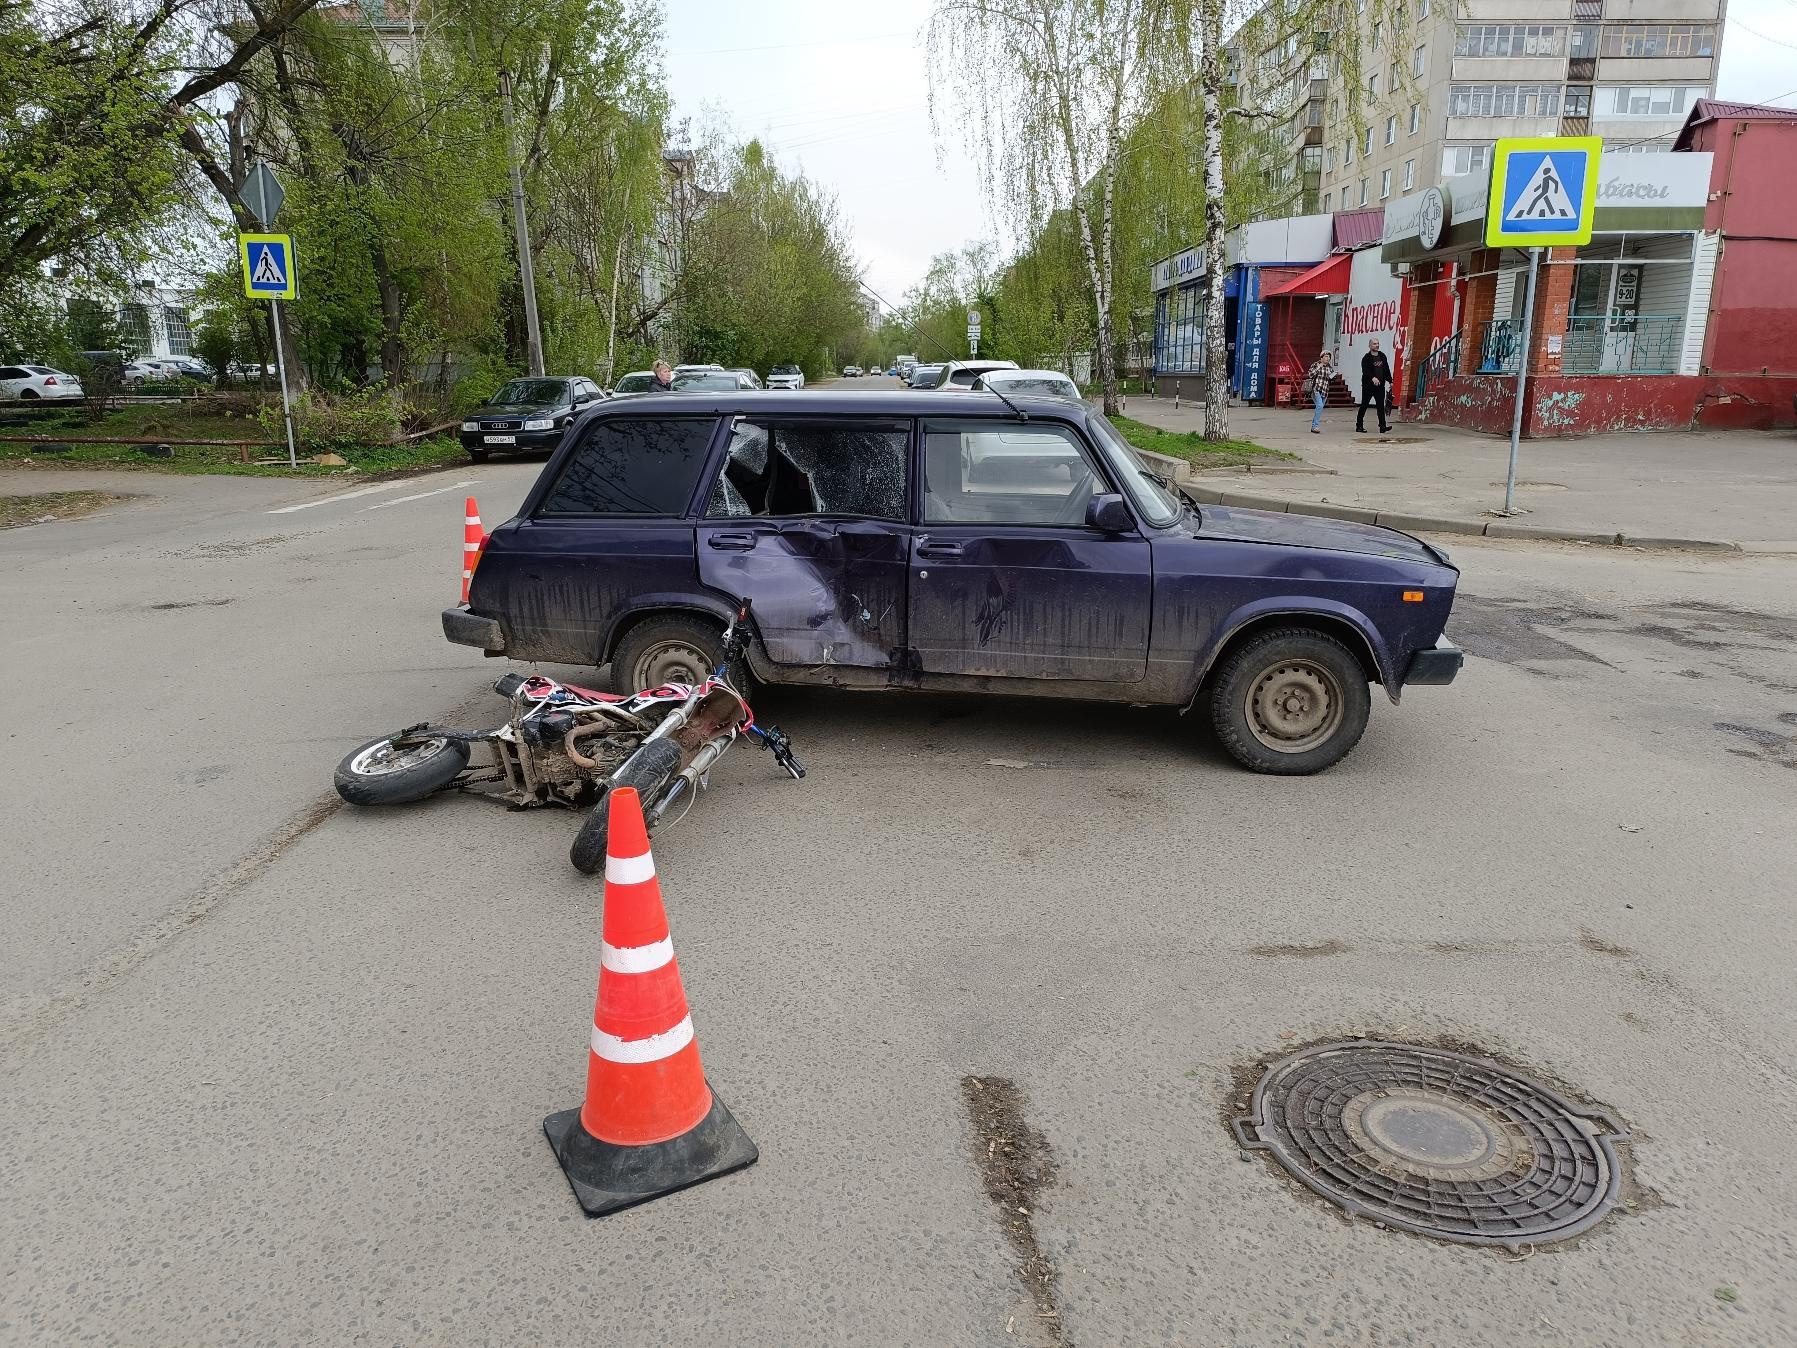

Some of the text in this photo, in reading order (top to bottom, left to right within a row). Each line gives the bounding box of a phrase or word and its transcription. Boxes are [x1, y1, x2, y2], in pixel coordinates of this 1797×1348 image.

[1618, 289, 1635, 299] 9-20
[1341, 295, 1396, 346] Красное
[1249, 304, 1262, 398] ТОВАРЫ ДЛЯ ДОМА
